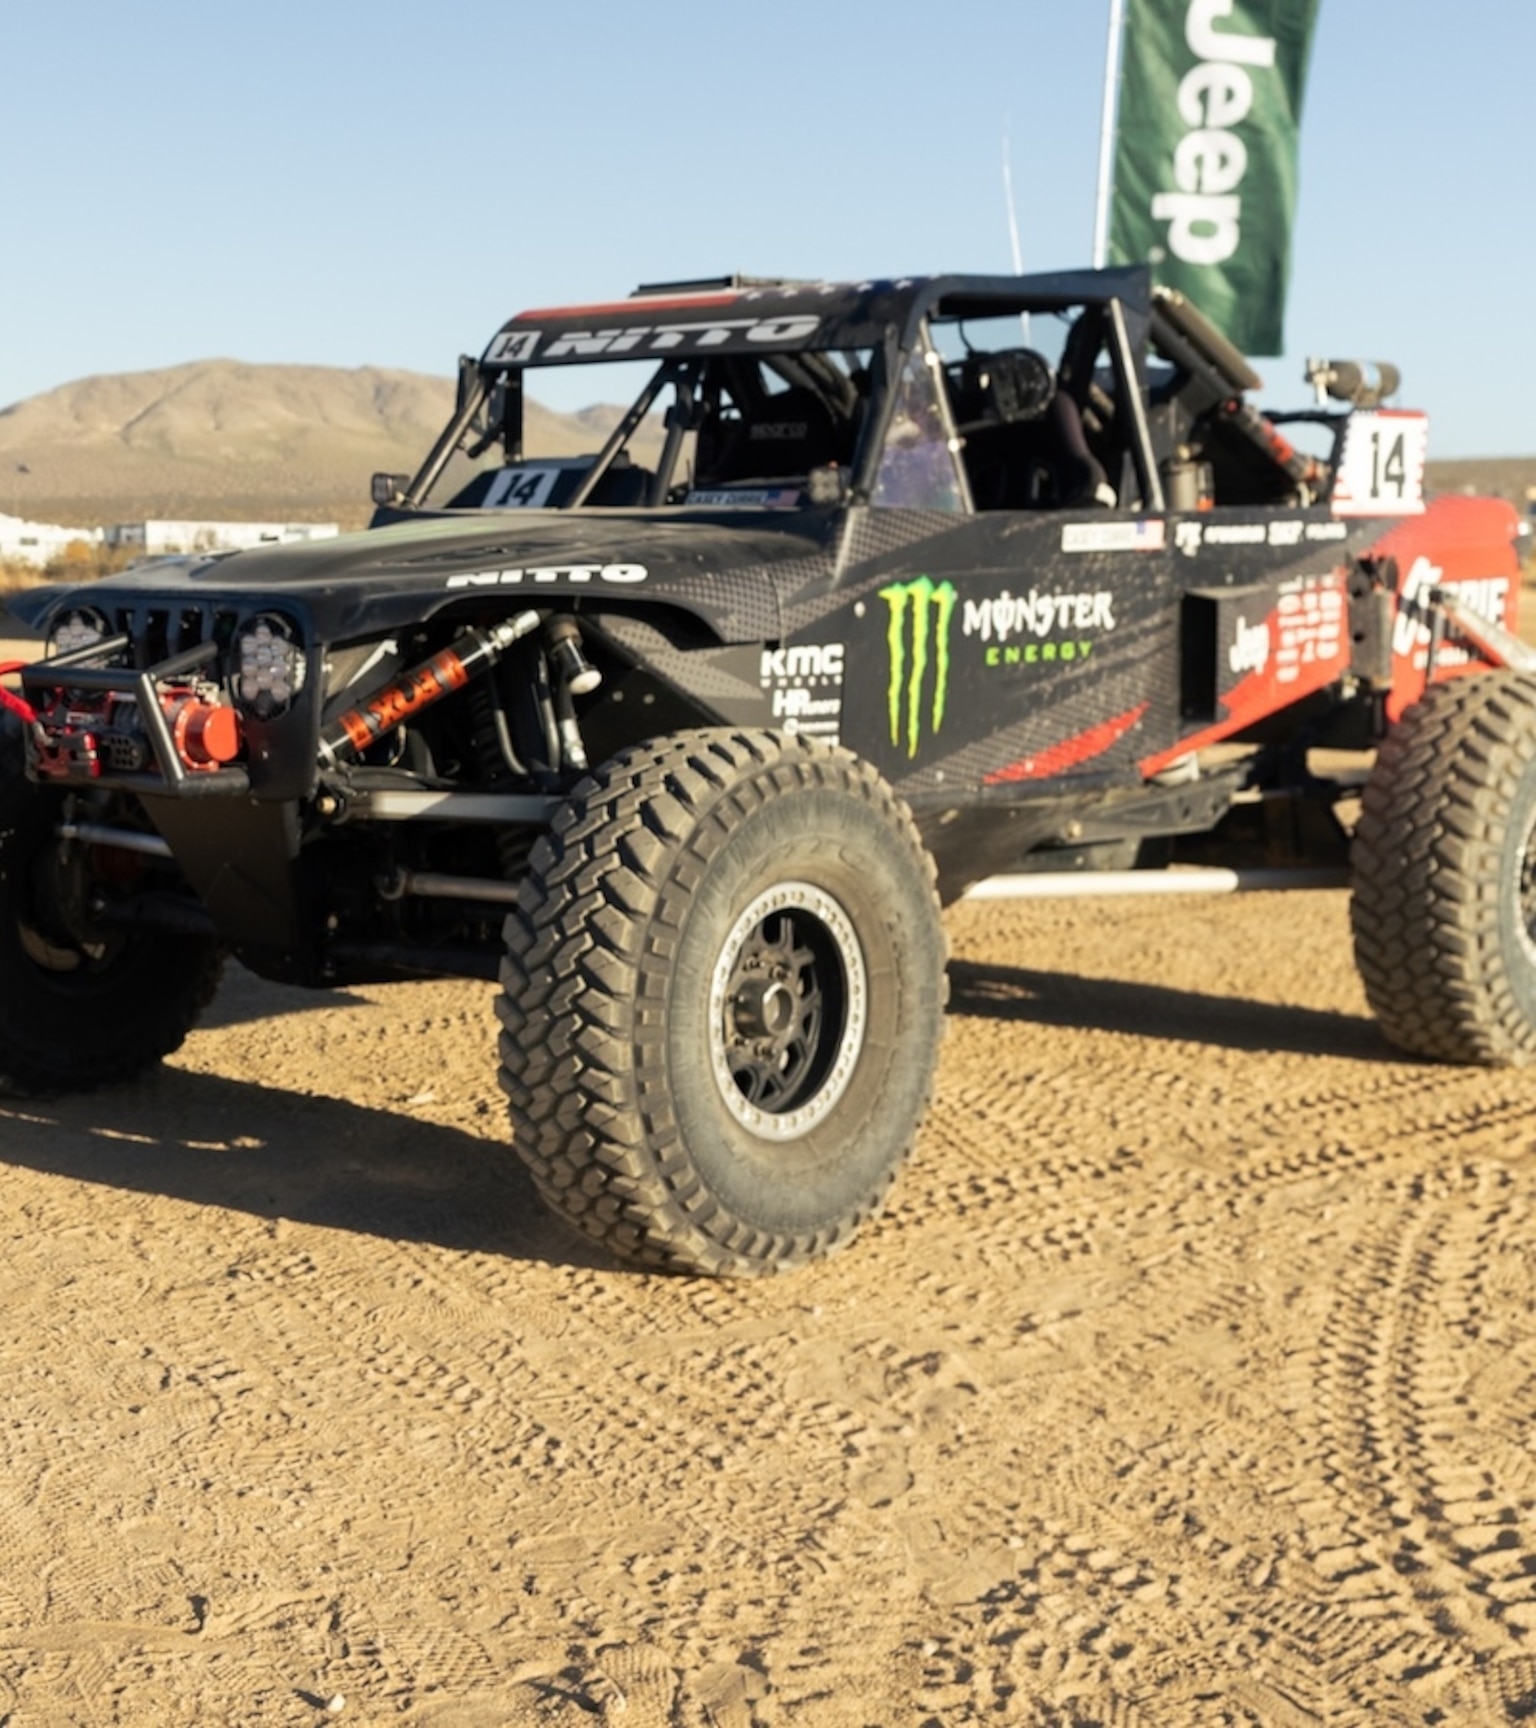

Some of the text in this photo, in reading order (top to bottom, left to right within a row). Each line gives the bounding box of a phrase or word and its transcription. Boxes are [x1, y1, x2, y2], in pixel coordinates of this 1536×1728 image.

[1152, 0, 1275, 265] Jeep
[496, 334, 529, 360] 14
[543, 315, 821, 358] NITTO
[1371, 431, 1406, 498] 14
[496, 472, 544, 506] 14
[446, 564, 648, 587] NITTO
[963, 590, 1115, 642] MONSTER
[986, 641, 1093, 666] ENERGY
